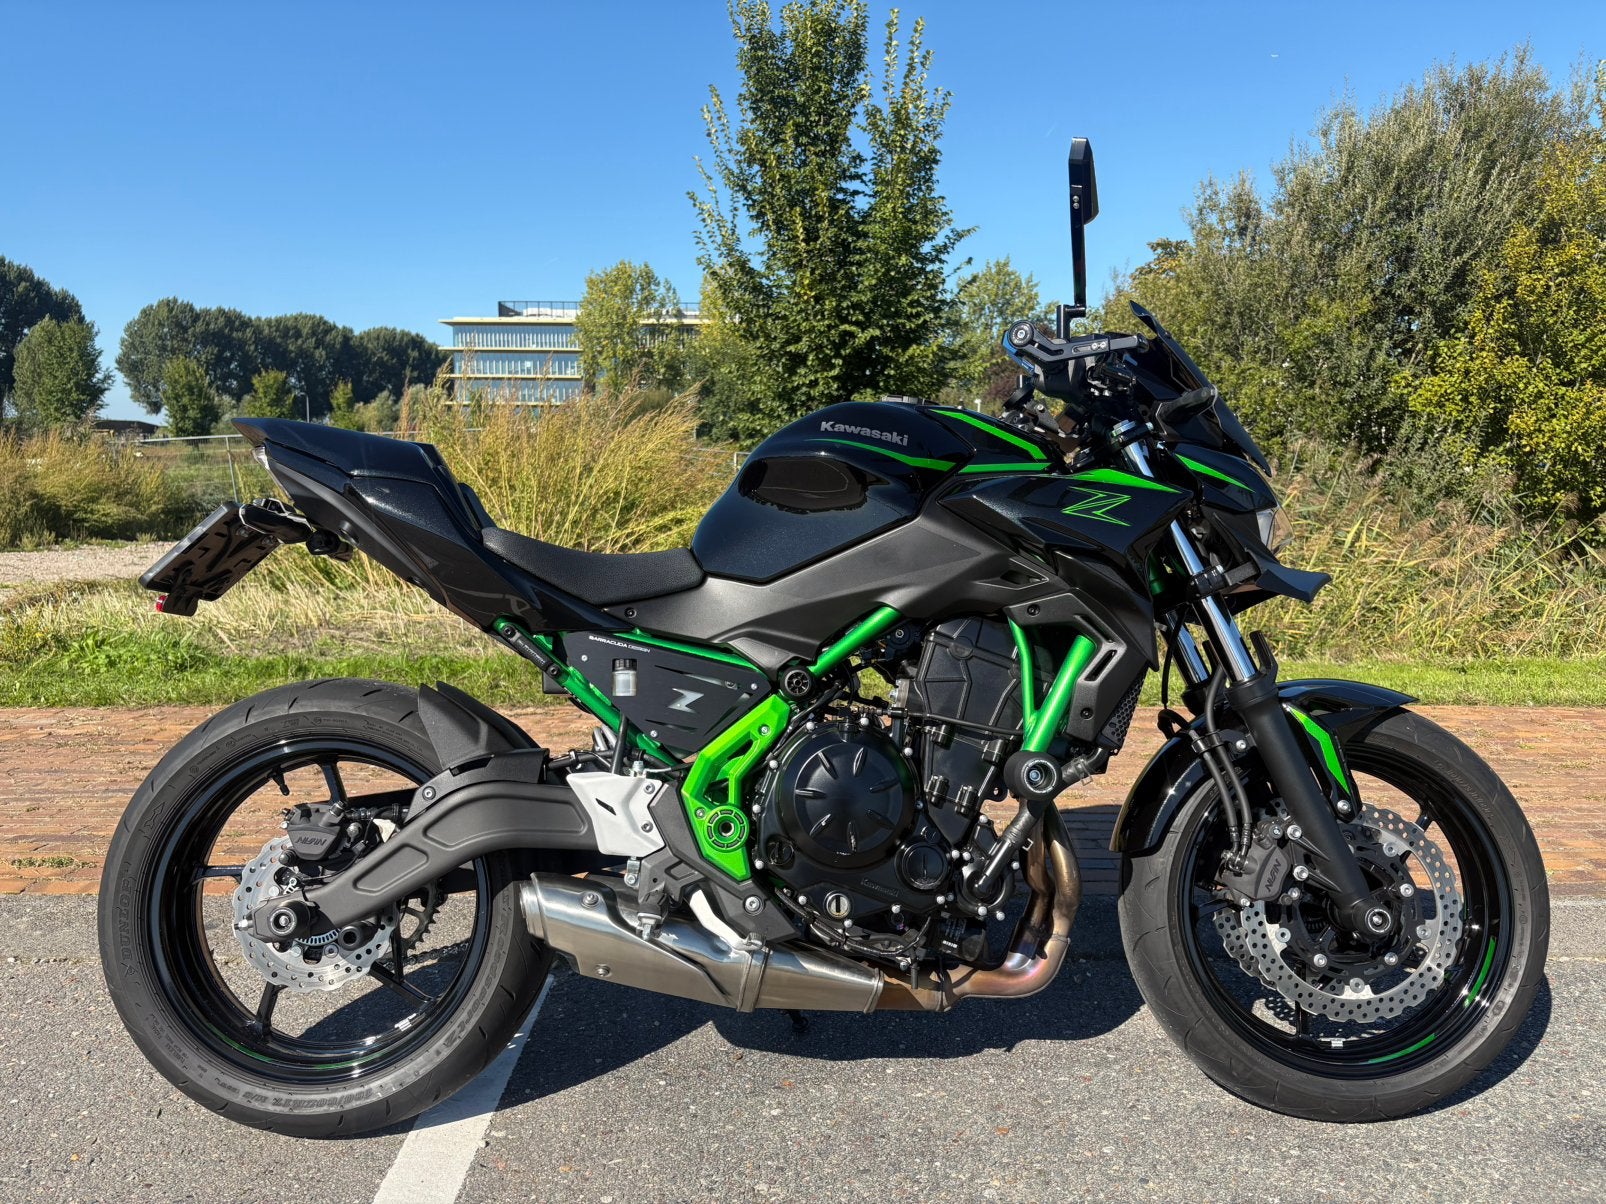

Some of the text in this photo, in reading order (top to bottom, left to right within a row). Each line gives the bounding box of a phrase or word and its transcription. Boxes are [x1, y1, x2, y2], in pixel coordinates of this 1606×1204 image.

[820, 421, 909, 446] Kawasaki
[1061, 485, 1132, 527] Z
[588, 635, 628, 648] BARRACUDA
[119, 878, 133, 960] DUNLOP
